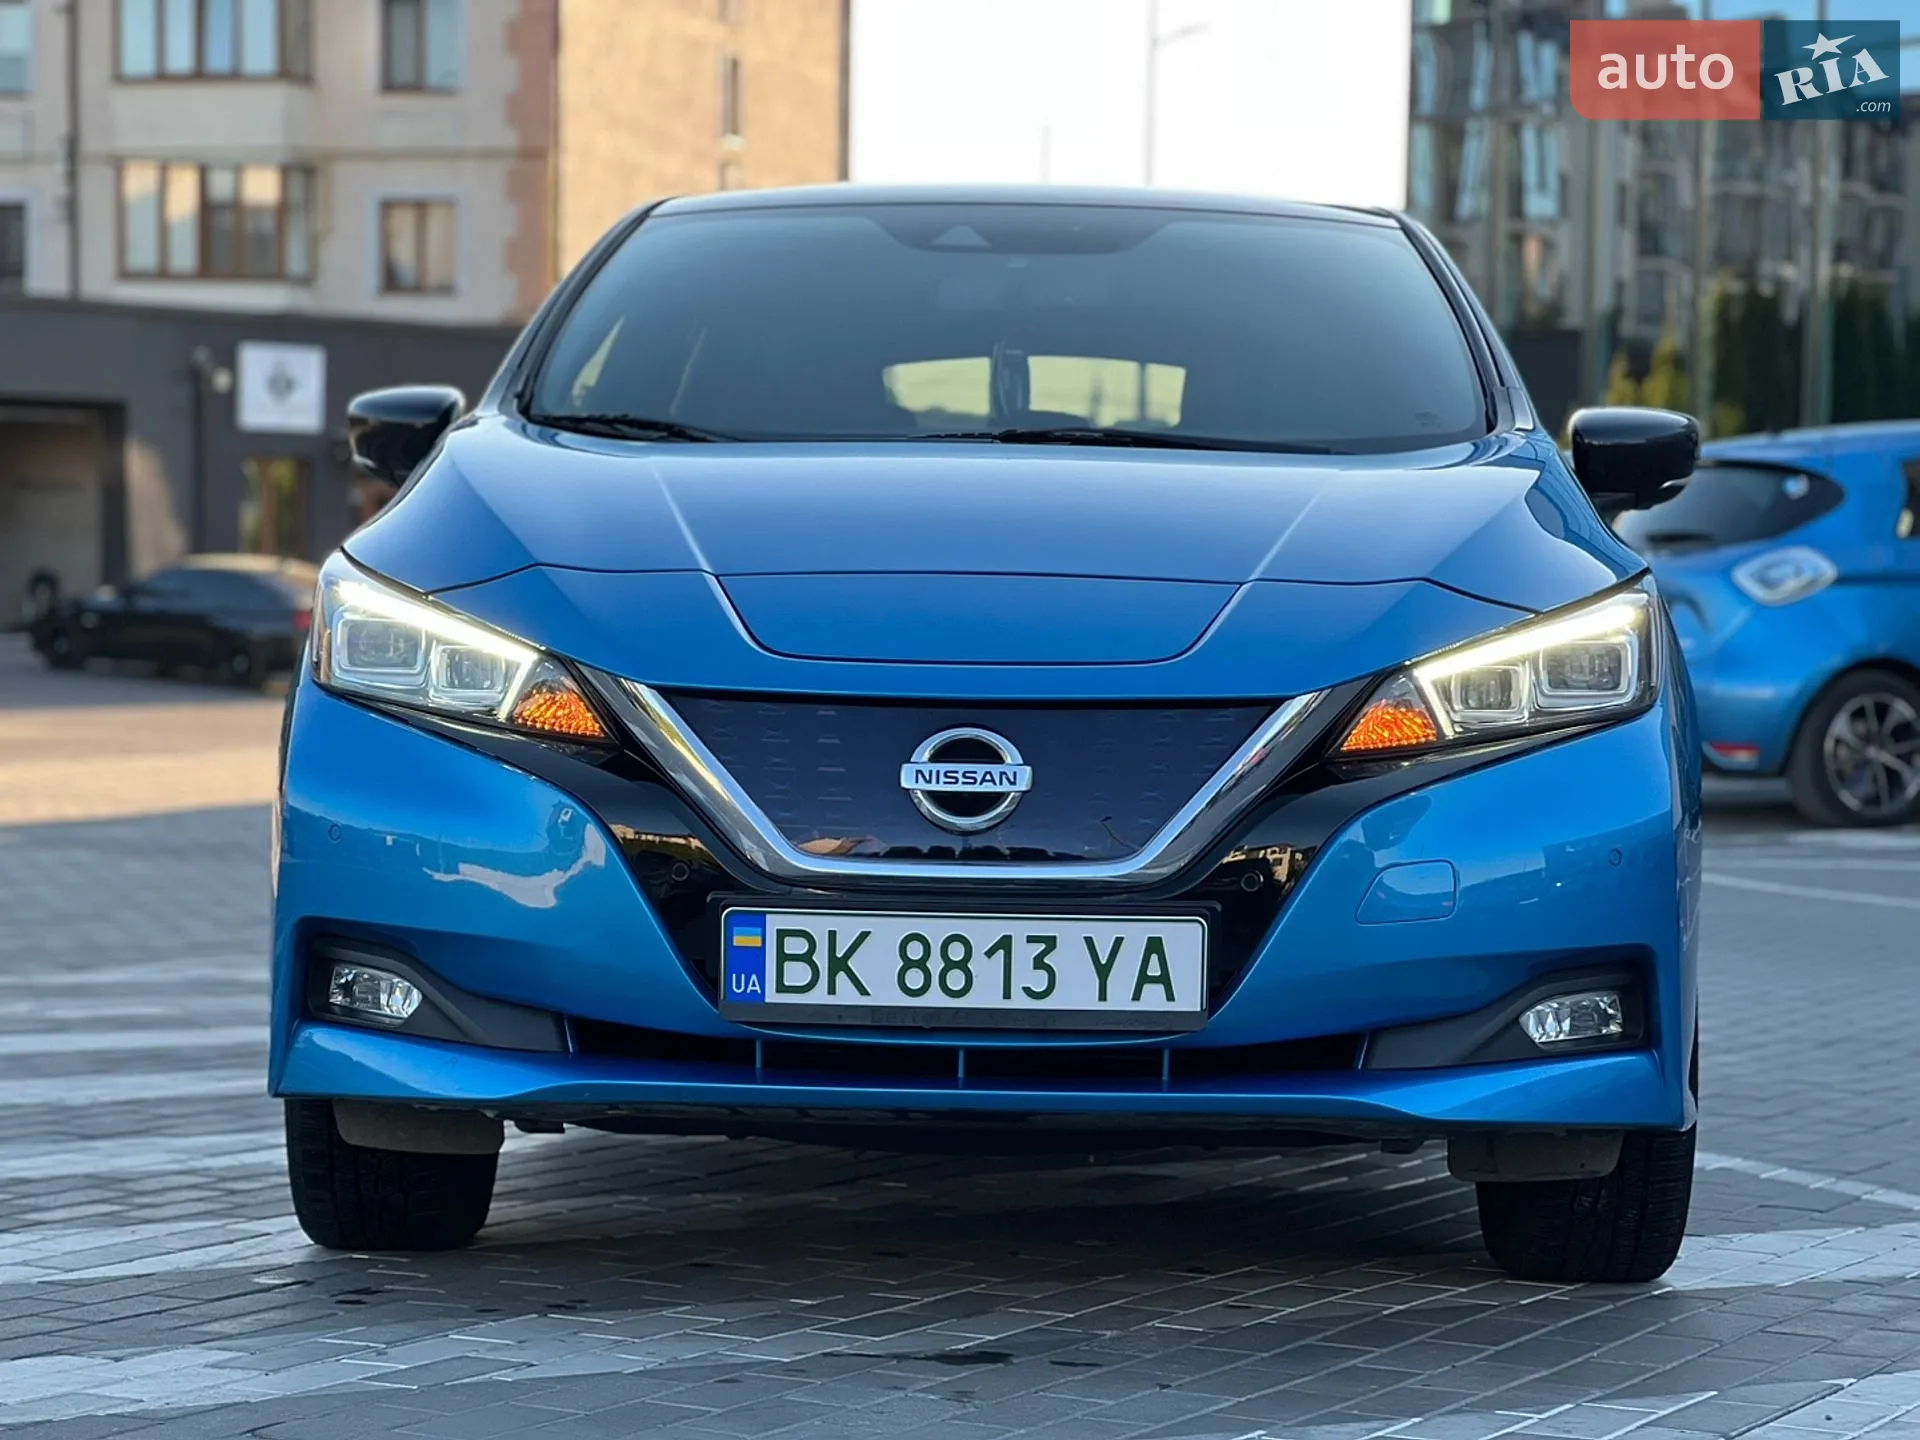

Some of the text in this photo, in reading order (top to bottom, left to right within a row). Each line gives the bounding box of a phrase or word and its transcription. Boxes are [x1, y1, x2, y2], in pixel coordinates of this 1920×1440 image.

[914, 769, 1018, 786] NISSAN
[774, 927, 1177, 1003] BK 8813 YA
[731, 973, 762, 994] UA
